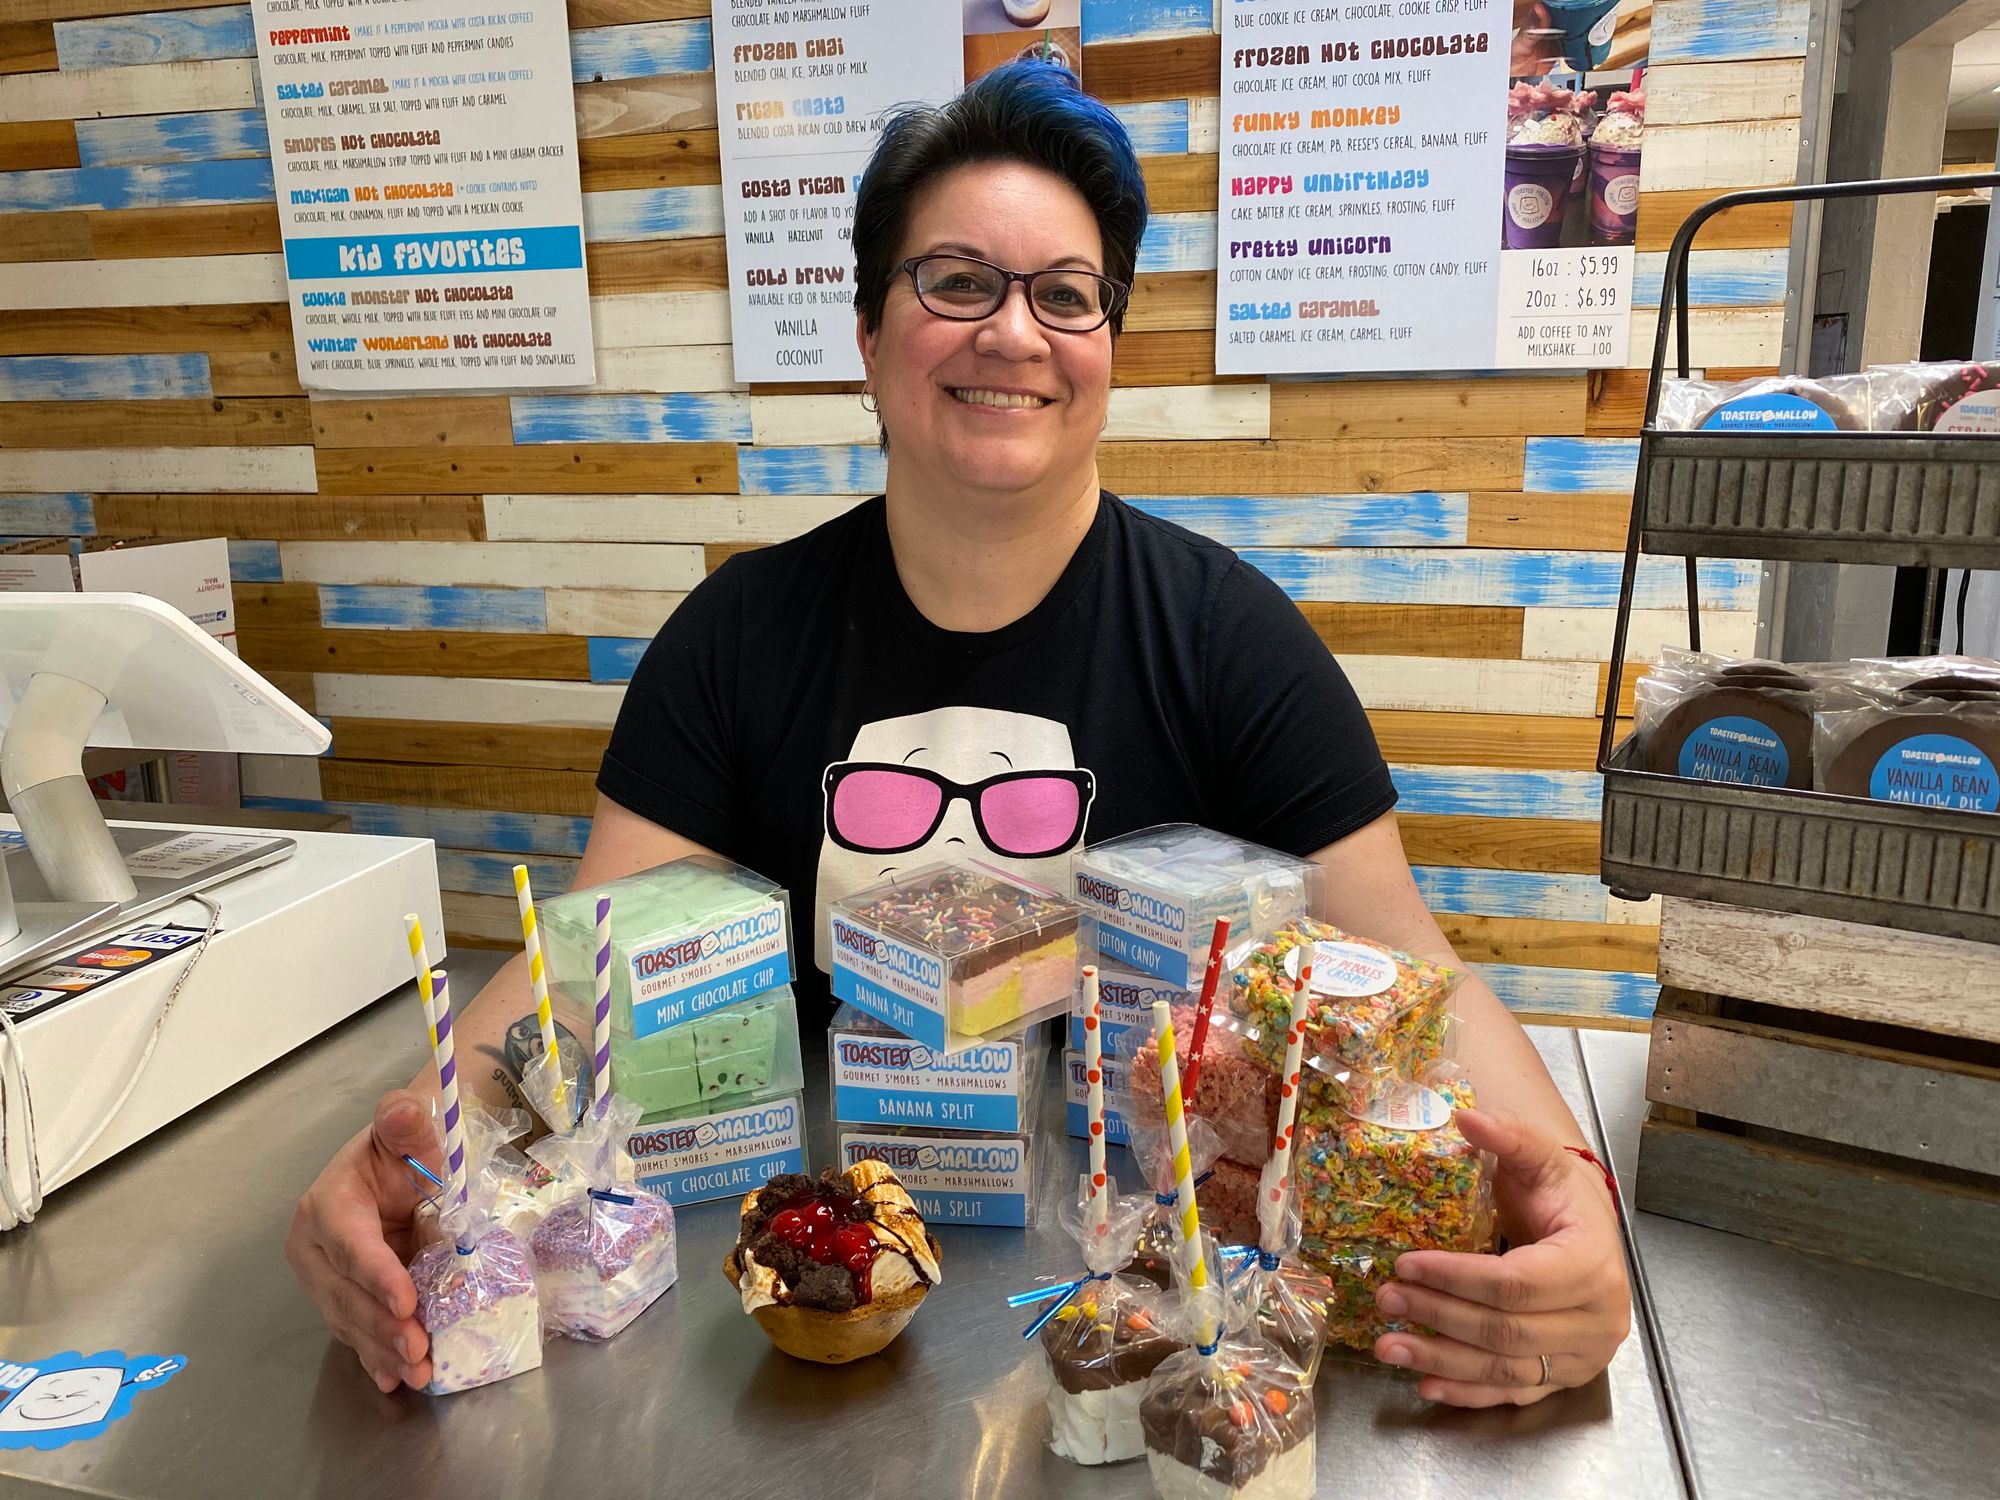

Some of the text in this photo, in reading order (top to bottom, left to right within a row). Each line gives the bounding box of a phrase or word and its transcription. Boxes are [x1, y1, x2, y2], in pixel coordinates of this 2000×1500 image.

[732, 5, 870, 27] CHOCOLATE AND MARSHMALLOW FLUFF
[1234, 79, 1276, 93] CHOCOLATE
[1282, 78, 1293, 91] ICE
[1333, 74, 1347, 87] HOT
[1353, 72, 1379, 86] COCOA
[1408, 69, 1431, 83] FLUFF
[1233, 142, 1275, 156] CHOCOLATE
[1281, 142, 1292, 155] ICE
[1348, 137, 1378, 151] REESE'S
[1465, 132, 1488, 145] FLUFF
[1232, 208, 1252, 220] CAKE
[1257, 206, 1284, 219] BATTER
[1288, 206, 1300, 218] ICE
[1433, 199, 1455, 212] FLUFF
[745, 229, 822, 244] VANILLA HAZELNUT
[775, 319, 817, 336] VANILLA
[1229, 331, 1255, 344] SALTED
[1260, 330, 1295, 343] CARAMEL
[1301, 330, 1312, 342] ICE
[1390, 327, 1412, 339] FLUFF
[1518, 324, 1612, 339] ADD COFFEE TO ANY
[776, 349, 823, 365] COCONUT
[1721, 410, 1818, 421] TOASTED MALLOW
[1710, 728, 1738, 739] TOASTED
[1746, 735, 1776, 747] MALLOW
[1694, 742, 1741, 767] VANILLA
[1748, 754, 1781, 776] BEAN
[1902, 750, 1981, 765] TOASTED MALLOW
[1888, 768, 1989, 795] VANILLA BEAN
[1076, 873, 1184, 932] TOASTED MALLOW
[130, 932, 192, 945] VISA
[1103, 911, 1182, 949] S'MORES MARSHMALLOWS
[633, 908, 781, 978] TOASTED MALLOW
[833, 920, 941, 989] TOASTED MALLOW
[1097, 930, 1161, 970] COTTON CANDY
[42, 970, 104, 980] DISCOVER
[641, 938, 780, 996] GOURMET S'MORES MARSHMALLOWS
[837, 948, 938, 1006] GOURMET S'MORES MARSHMALLOWS
[1327, 968, 1371, 987] CRISPIE
[1338, 959, 1384, 980] PEBBLES
[657, 967, 774, 1025] MINT CHOCOLATE CHIP
[855, 983, 914, 1028] BANANA SPLIT
[839, 1040, 1010, 1073] TOASTED MALLOW
[843, 1070, 1007, 1089] GOURMET S'MORES MARSHMALLOWS
[879, 1098, 974, 1120] BANANA SPLIT
[628, 1107, 792, 1157] TOASTED MALLOW
[635, 1135, 792, 1173] OURMET S'MORES MARSHMALLOWS
[938, 1147, 1017, 1173] MALLOW
[682, 1165, 752, 1194] CHOCOLATE
[759, 1160, 786, 1178] CHIP
[950, 1200, 982, 1217] SPLIT
